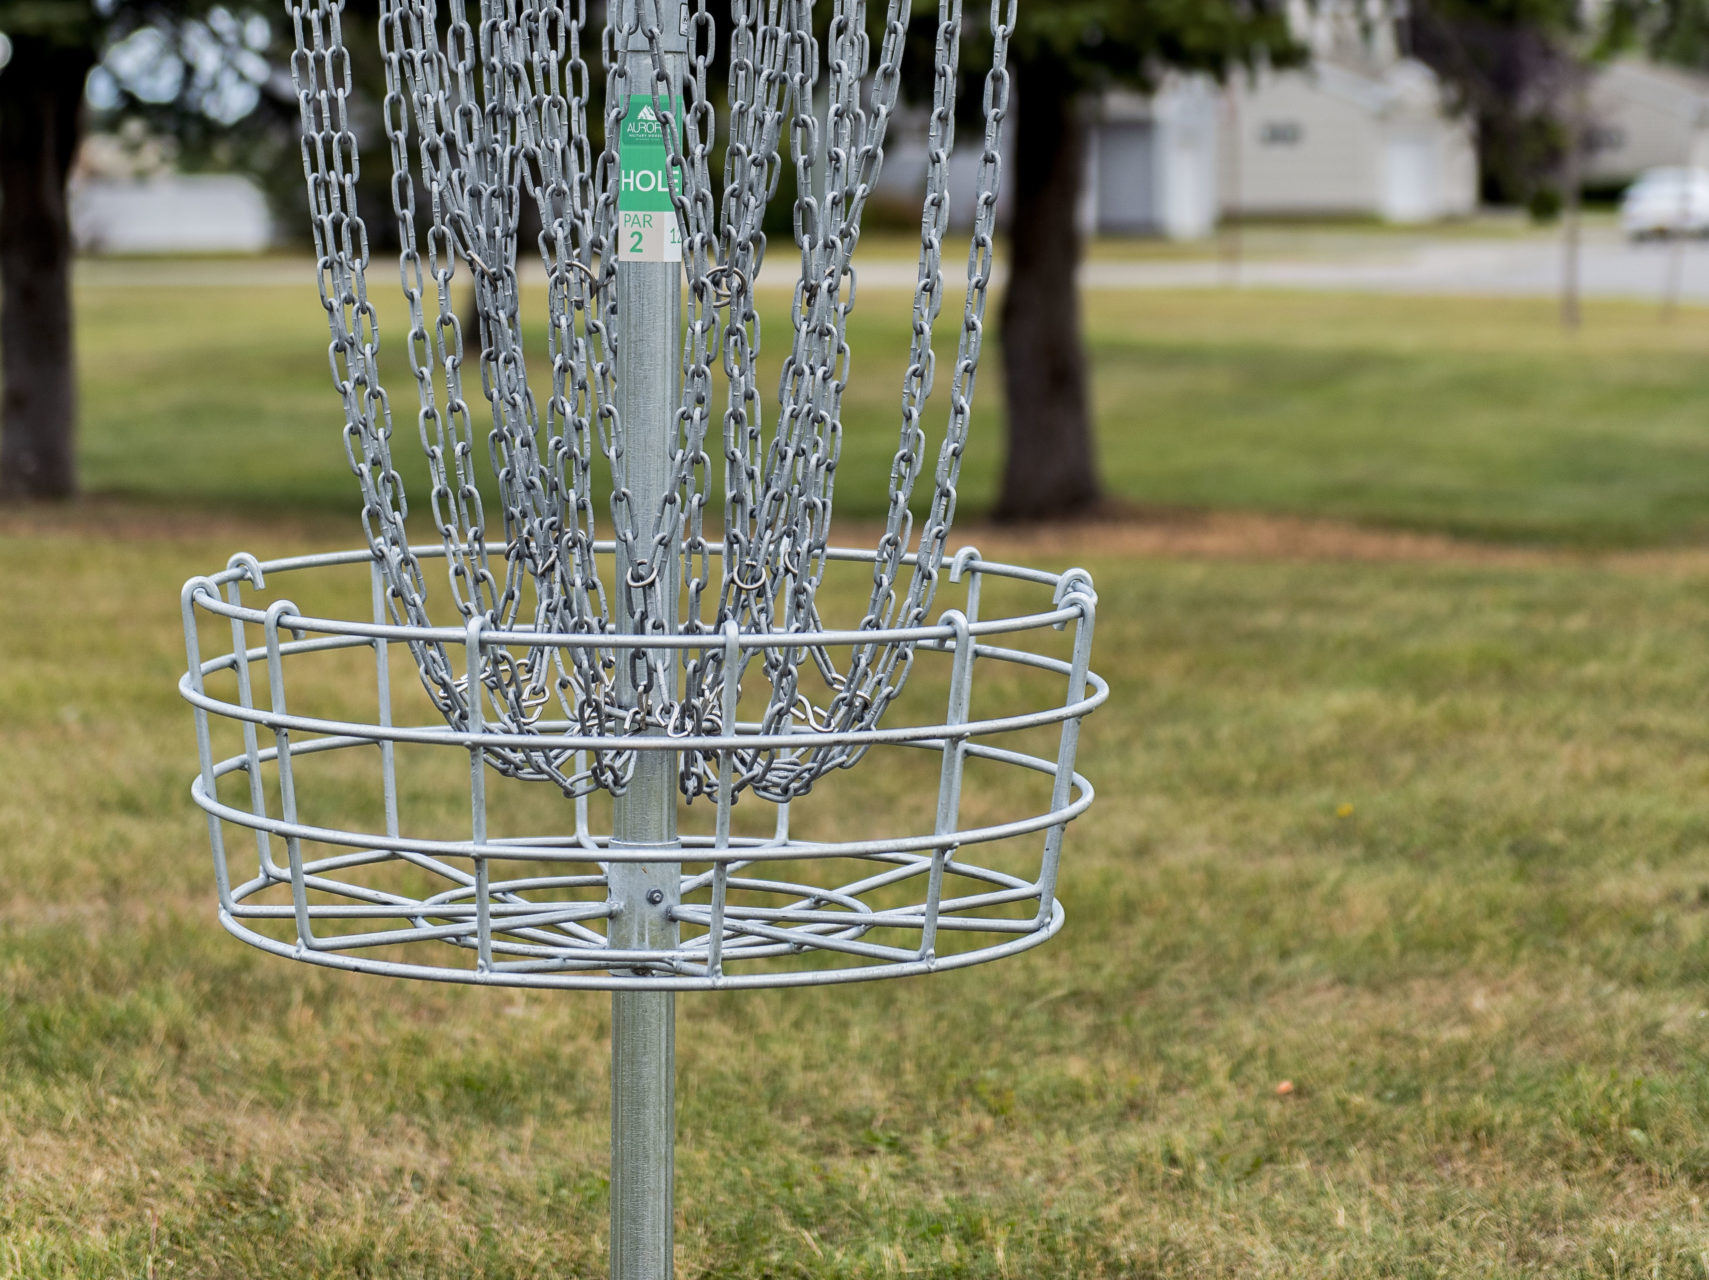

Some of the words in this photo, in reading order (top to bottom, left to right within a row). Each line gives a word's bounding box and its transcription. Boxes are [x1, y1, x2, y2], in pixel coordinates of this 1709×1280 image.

[626, 122, 664, 133] AUROR
[624, 213, 653, 228] PAR
[629, 231, 643, 253] 2
